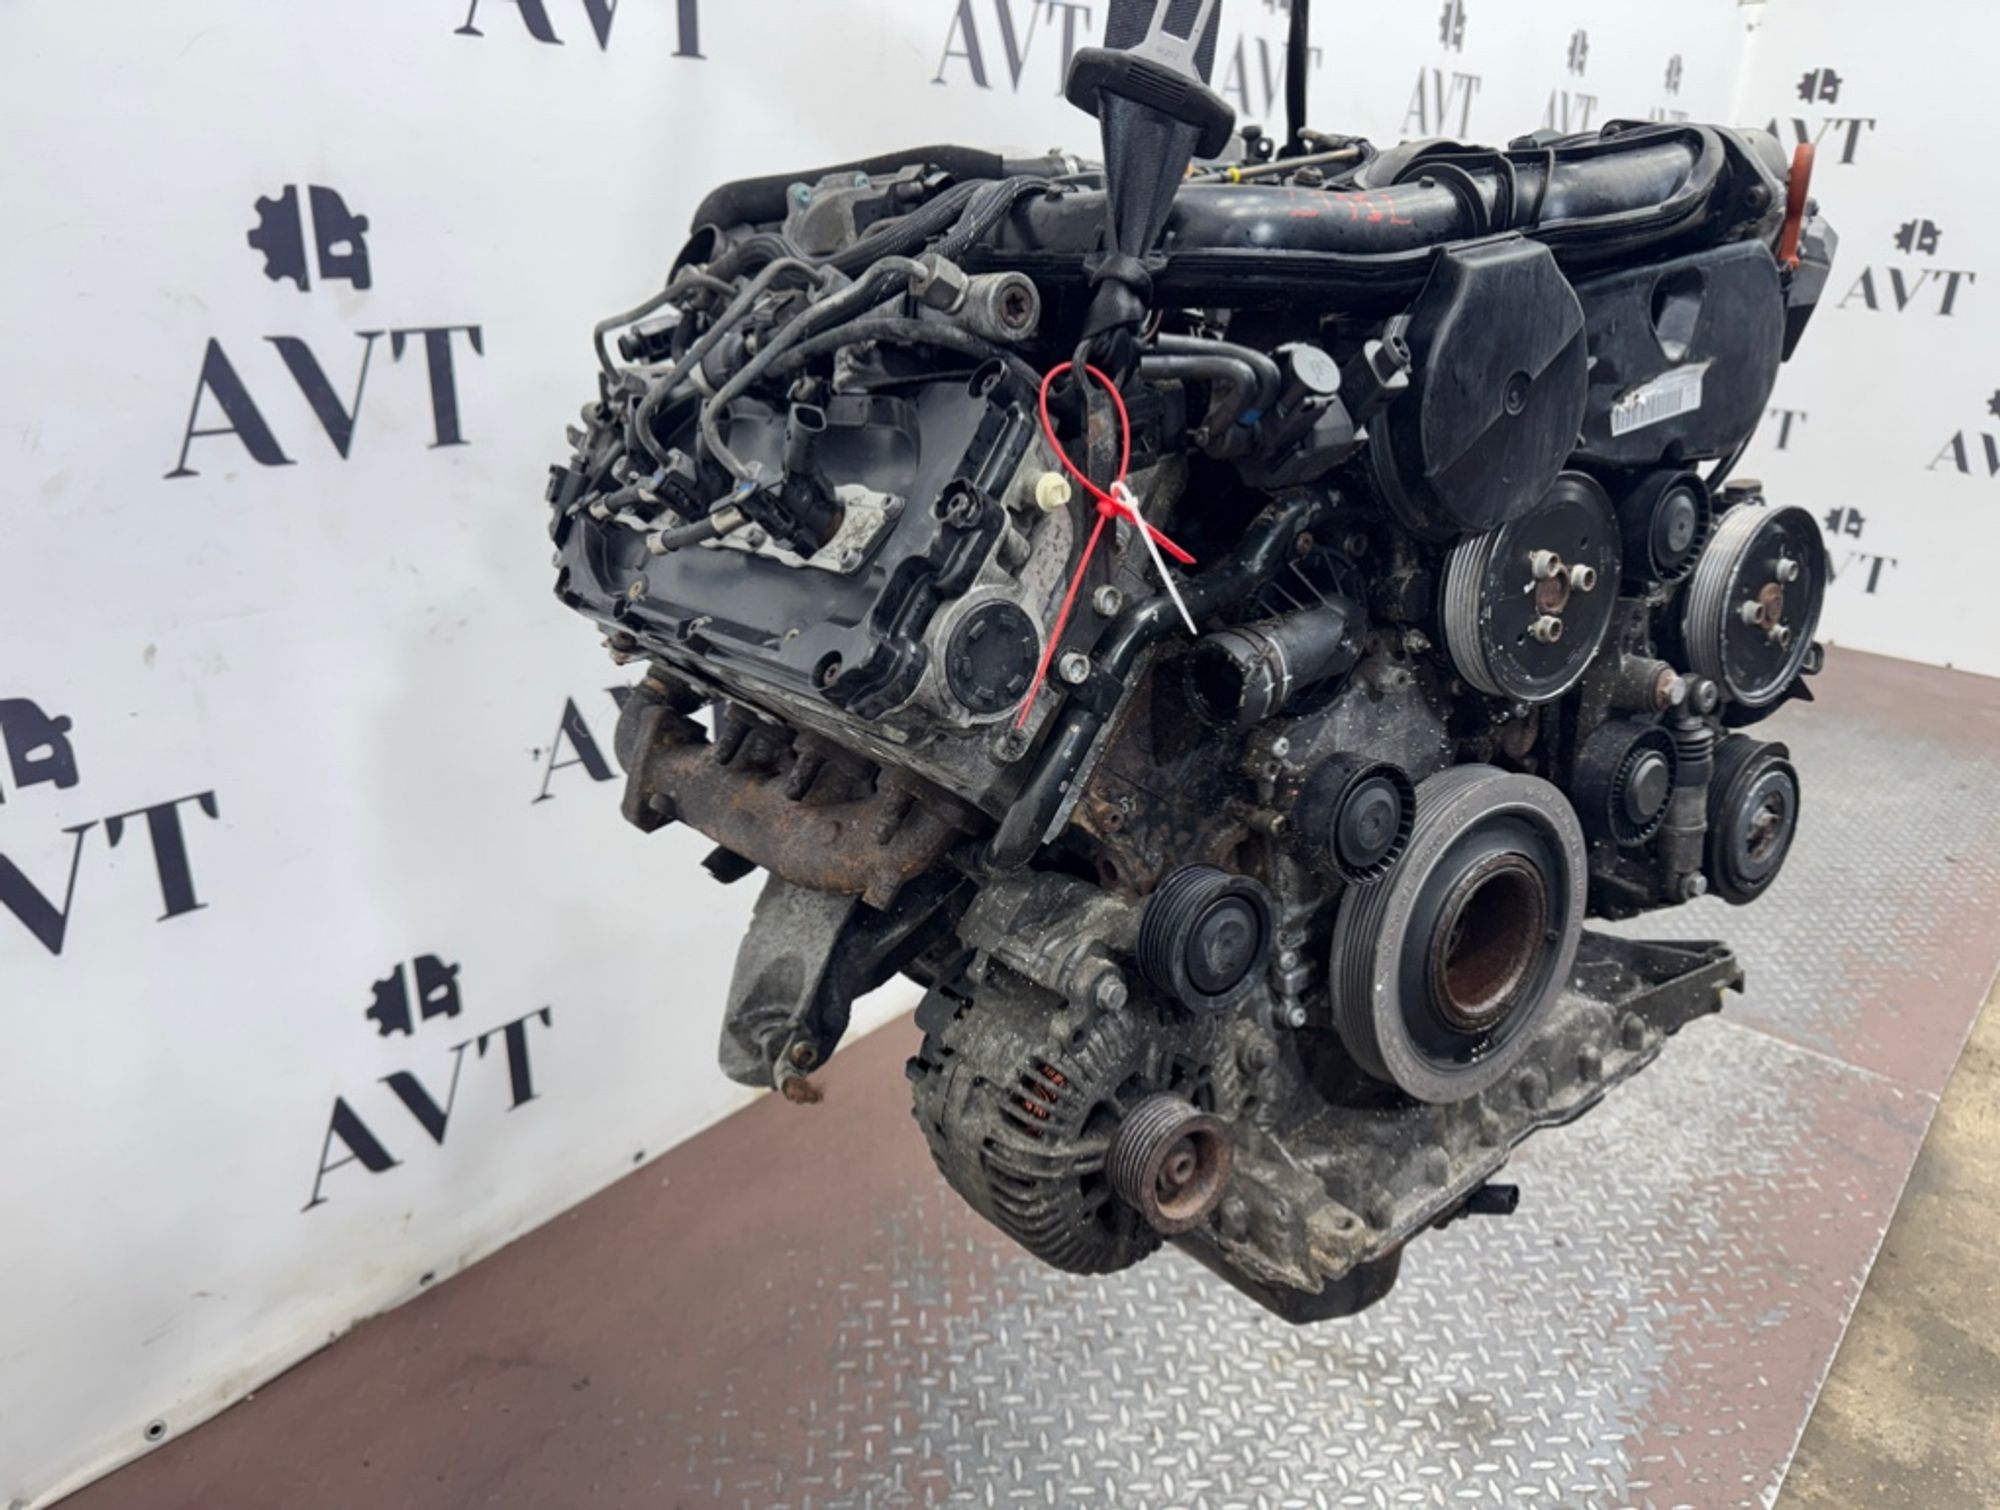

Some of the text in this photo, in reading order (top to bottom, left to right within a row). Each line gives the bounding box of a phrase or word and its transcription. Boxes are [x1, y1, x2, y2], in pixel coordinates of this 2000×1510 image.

[930, 0, 1092, 97] AVT
[1221, 32, 1323, 119] AV
[1401, 64, 1482, 139] AVT
[1836, 265, 1976, 317] AVT
[163, 324, 485, 480] AVT
[1924, 428, 2000, 479] AV
[1822, 546, 1898, 595] VT
[0, 789, 219, 956] VT
[301, 1005, 552, 1213] AVT
